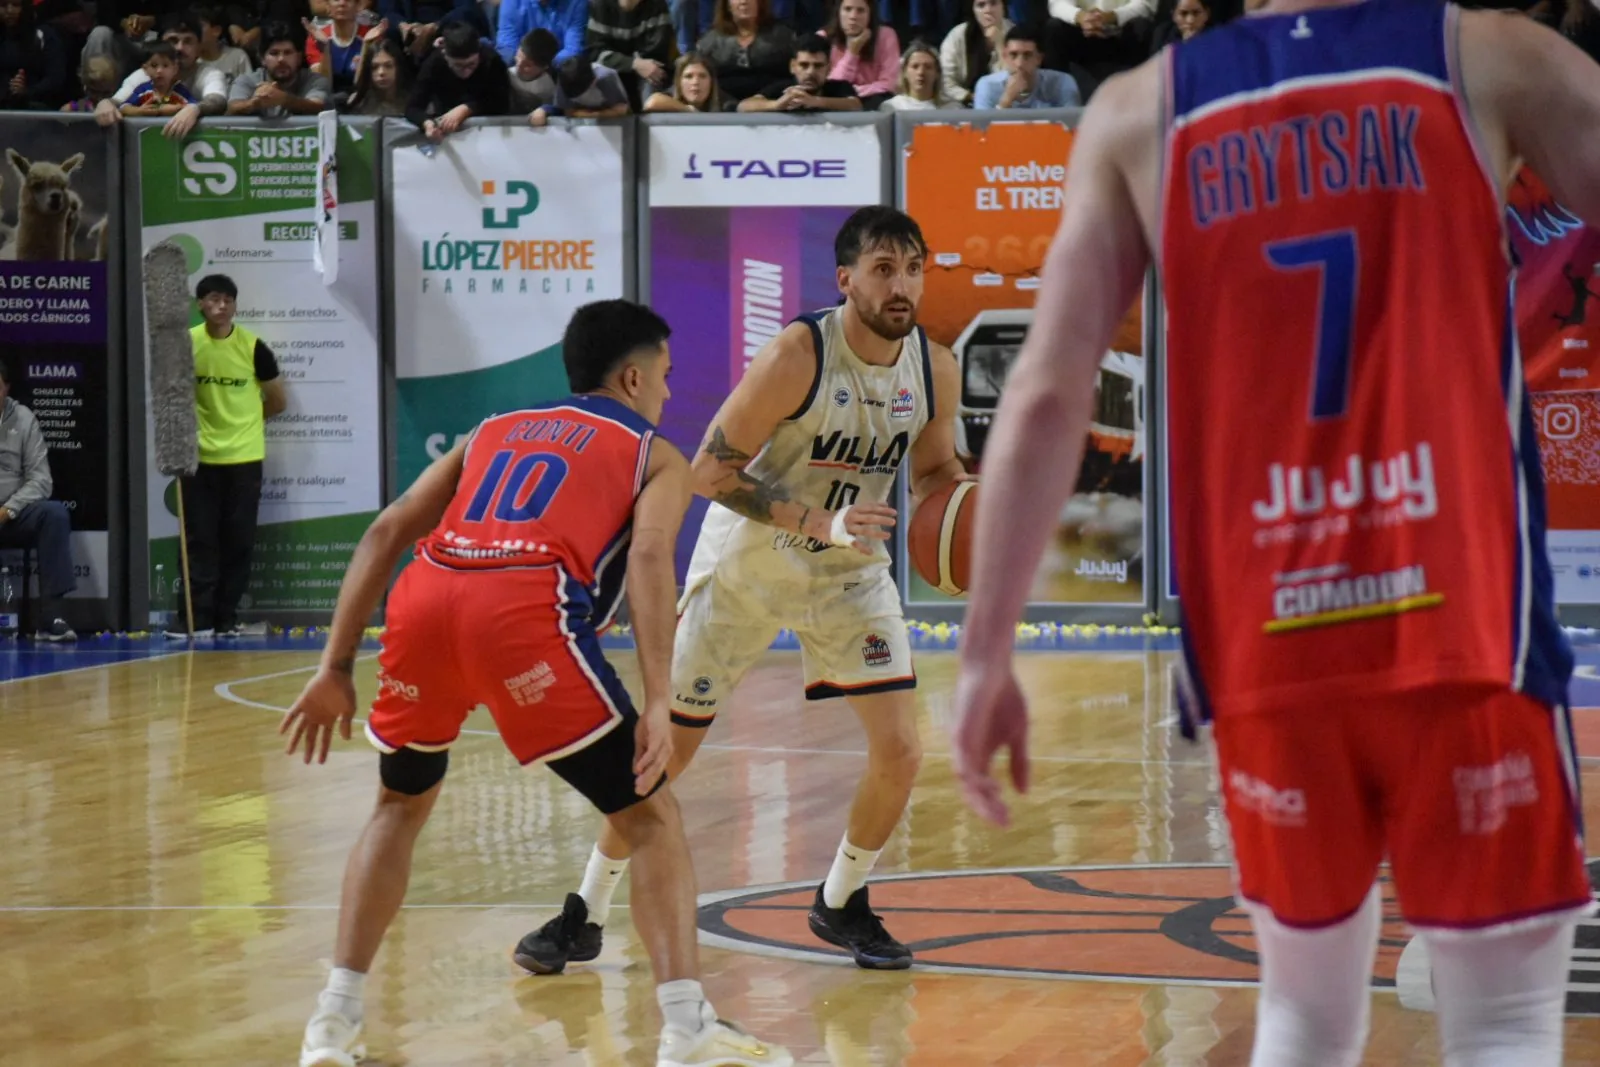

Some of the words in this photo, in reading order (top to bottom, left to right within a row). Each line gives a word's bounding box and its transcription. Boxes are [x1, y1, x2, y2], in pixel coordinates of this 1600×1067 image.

[710, 159, 847, 178] TADE
[982, 160, 1065, 182] vuelve
[1186, 103, 1425, 228] GRYTSAK
[976, 187, 1004, 210] EL
[215, 248, 274, 259] Informarse
[11, 275, 32, 290] DE
[34, 275, 92, 290] CARNE
[422, 277, 596, 294] FARMACIA
[36, 298, 45, 310] Y
[46, 298, 91, 310] LLAMA
[268, 309, 287, 318] sus
[289, 305, 338, 318] derechos
[31, 310, 92, 324] CÁRNICOS
[1263, 227, 1357, 425] 7
[271, 339, 288, 349] sus
[290, 338, 345, 349] consumos
[28, 364, 78, 378] LLAMA
[810, 429, 909, 467] VILLA
[296, 474, 346, 488] cualquier
[462, 448, 570, 524] 10
